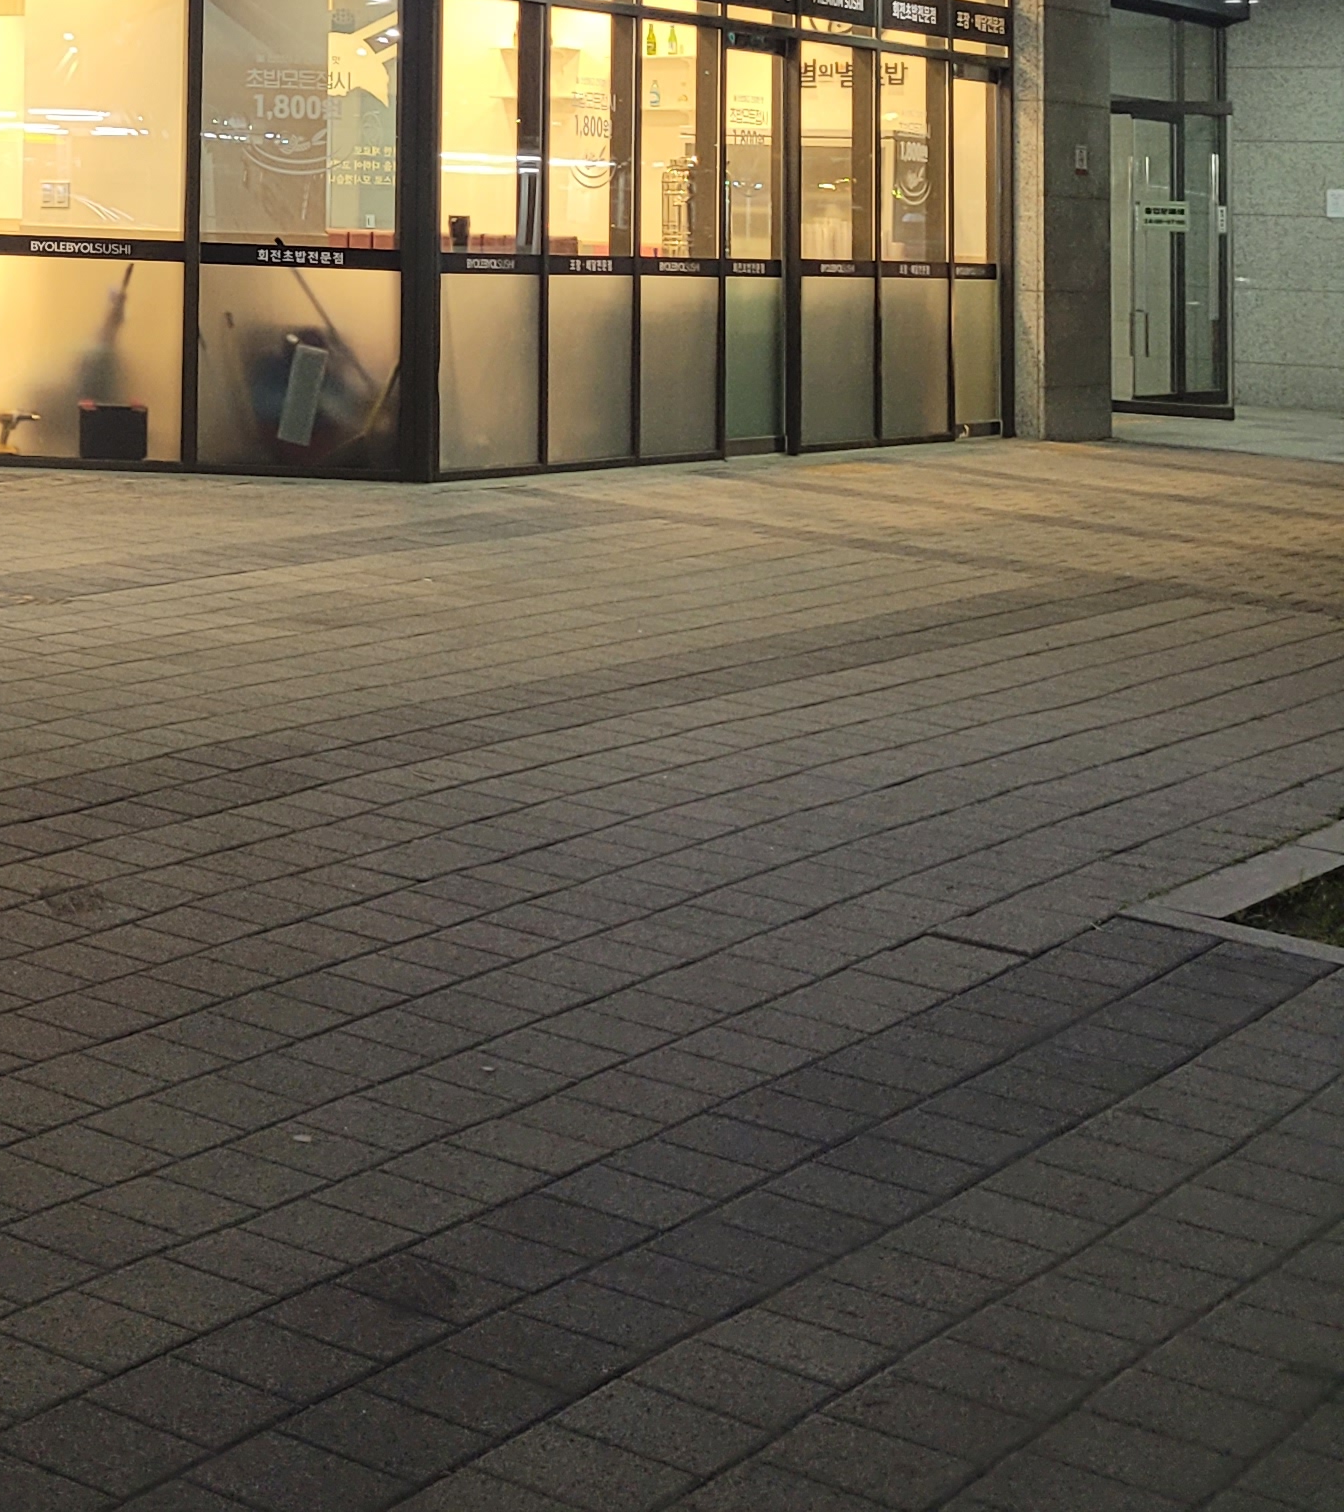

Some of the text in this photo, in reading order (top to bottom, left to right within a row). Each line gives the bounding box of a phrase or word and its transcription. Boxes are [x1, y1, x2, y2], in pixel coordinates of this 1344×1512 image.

[245, 67, 352, 91] 초밥모든접시
[253, 94, 343, 121] 1,800원
[30, 240, 132, 256] BYOLEBYOLSUSHI
[256, 248, 345, 265] 회전초밥전문점
